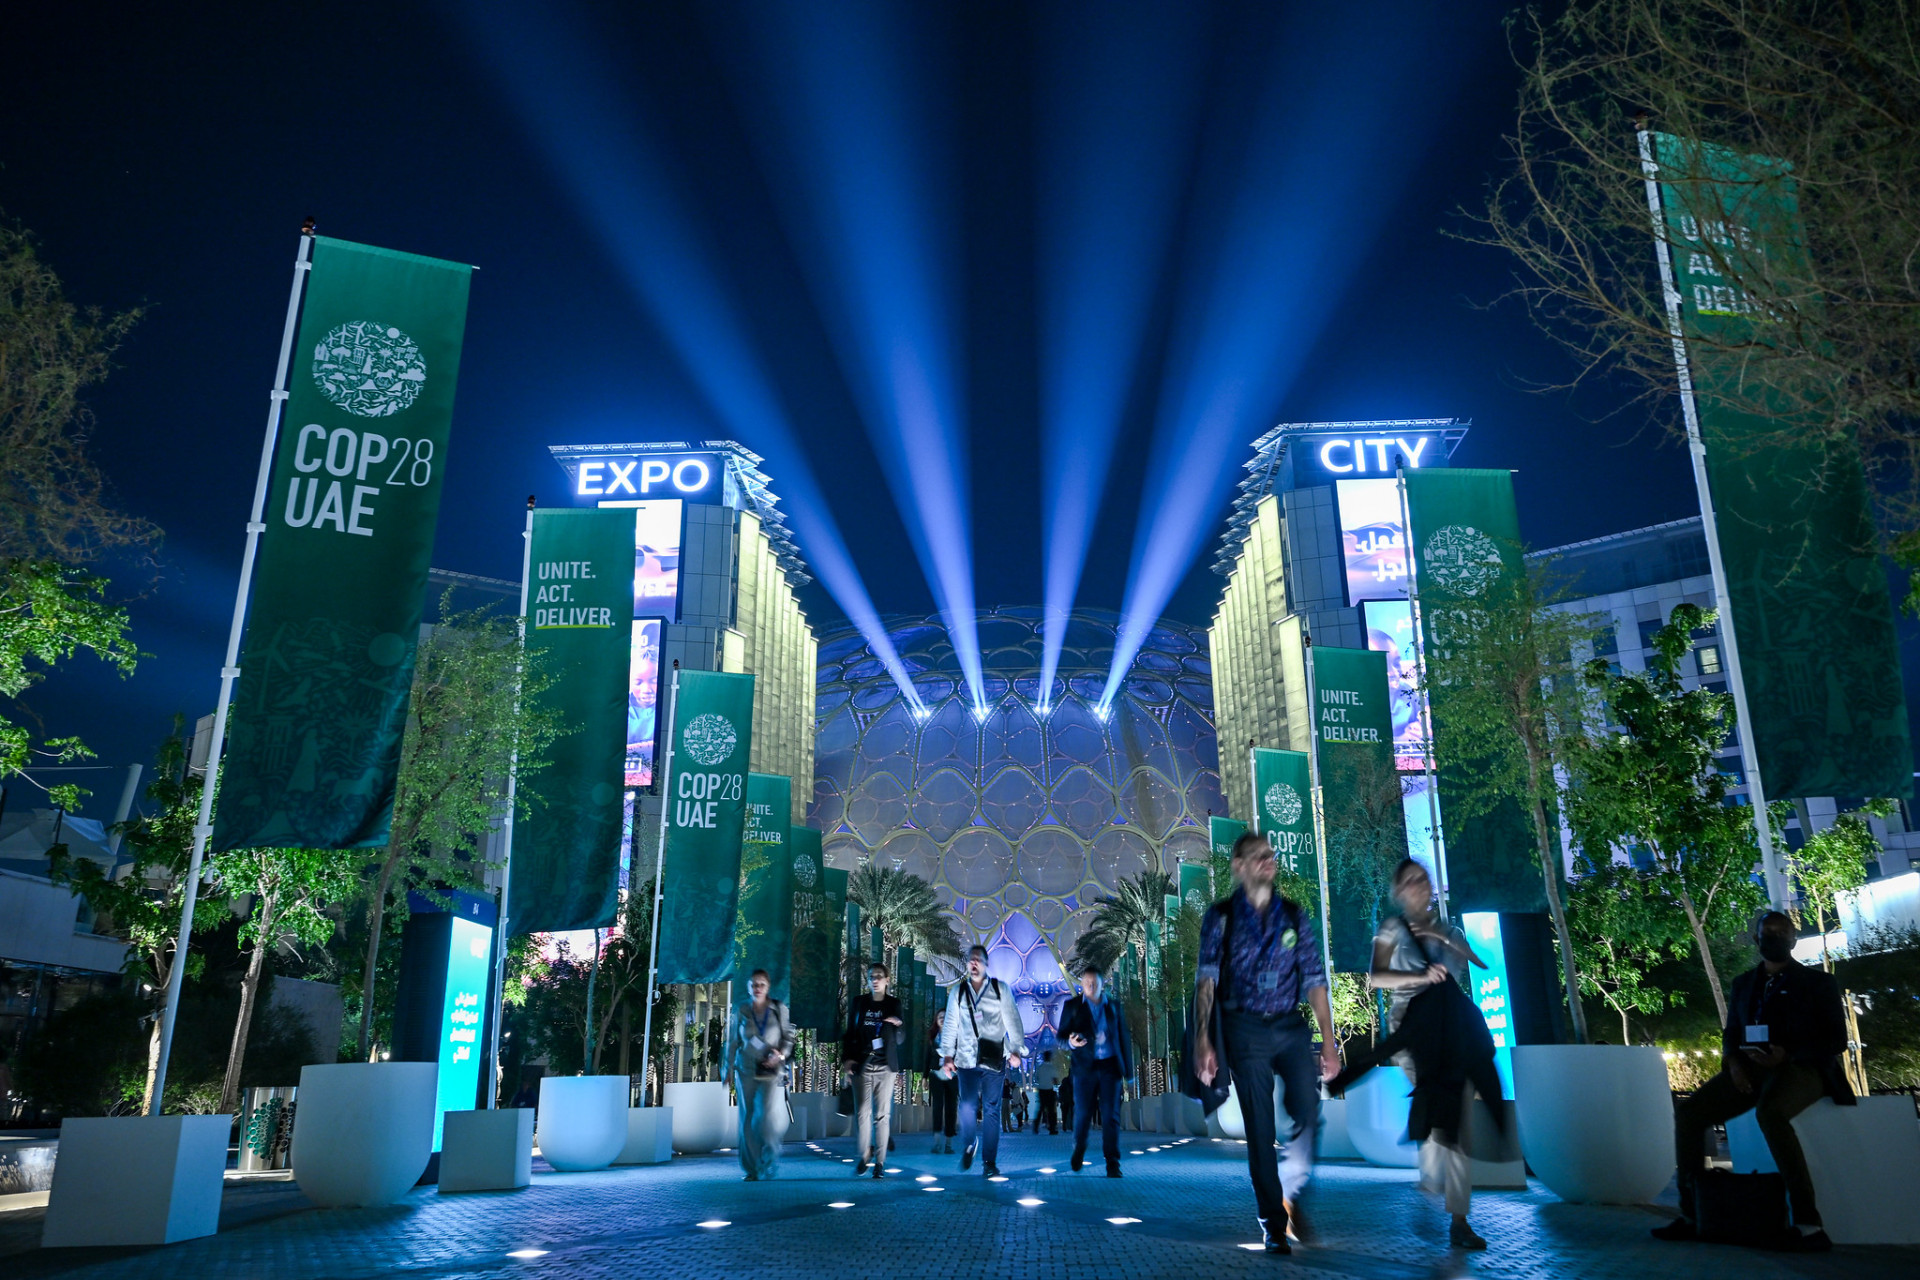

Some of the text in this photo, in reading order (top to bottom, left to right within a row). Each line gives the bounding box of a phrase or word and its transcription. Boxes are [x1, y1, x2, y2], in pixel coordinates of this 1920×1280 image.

[294, 424, 434, 487] COP28
[1320, 437, 1428, 473] CITY
[577, 459, 710, 495] EXPO
[284, 477, 380, 537] UAE
[538, 561, 596, 580] UNITE.
[535, 584, 575, 604] ACT.
[535, 607, 616, 627] DELIVER.
[1321, 689, 1364, 706] UNITE.
[1322, 708, 1350, 723] ACT.
[1323, 726, 1383, 743] DELIVER.
[678, 772, 742, 800] COP28
[676, 800, 718, 828] UAE
[1267, 830, 1313, 854] COP28
